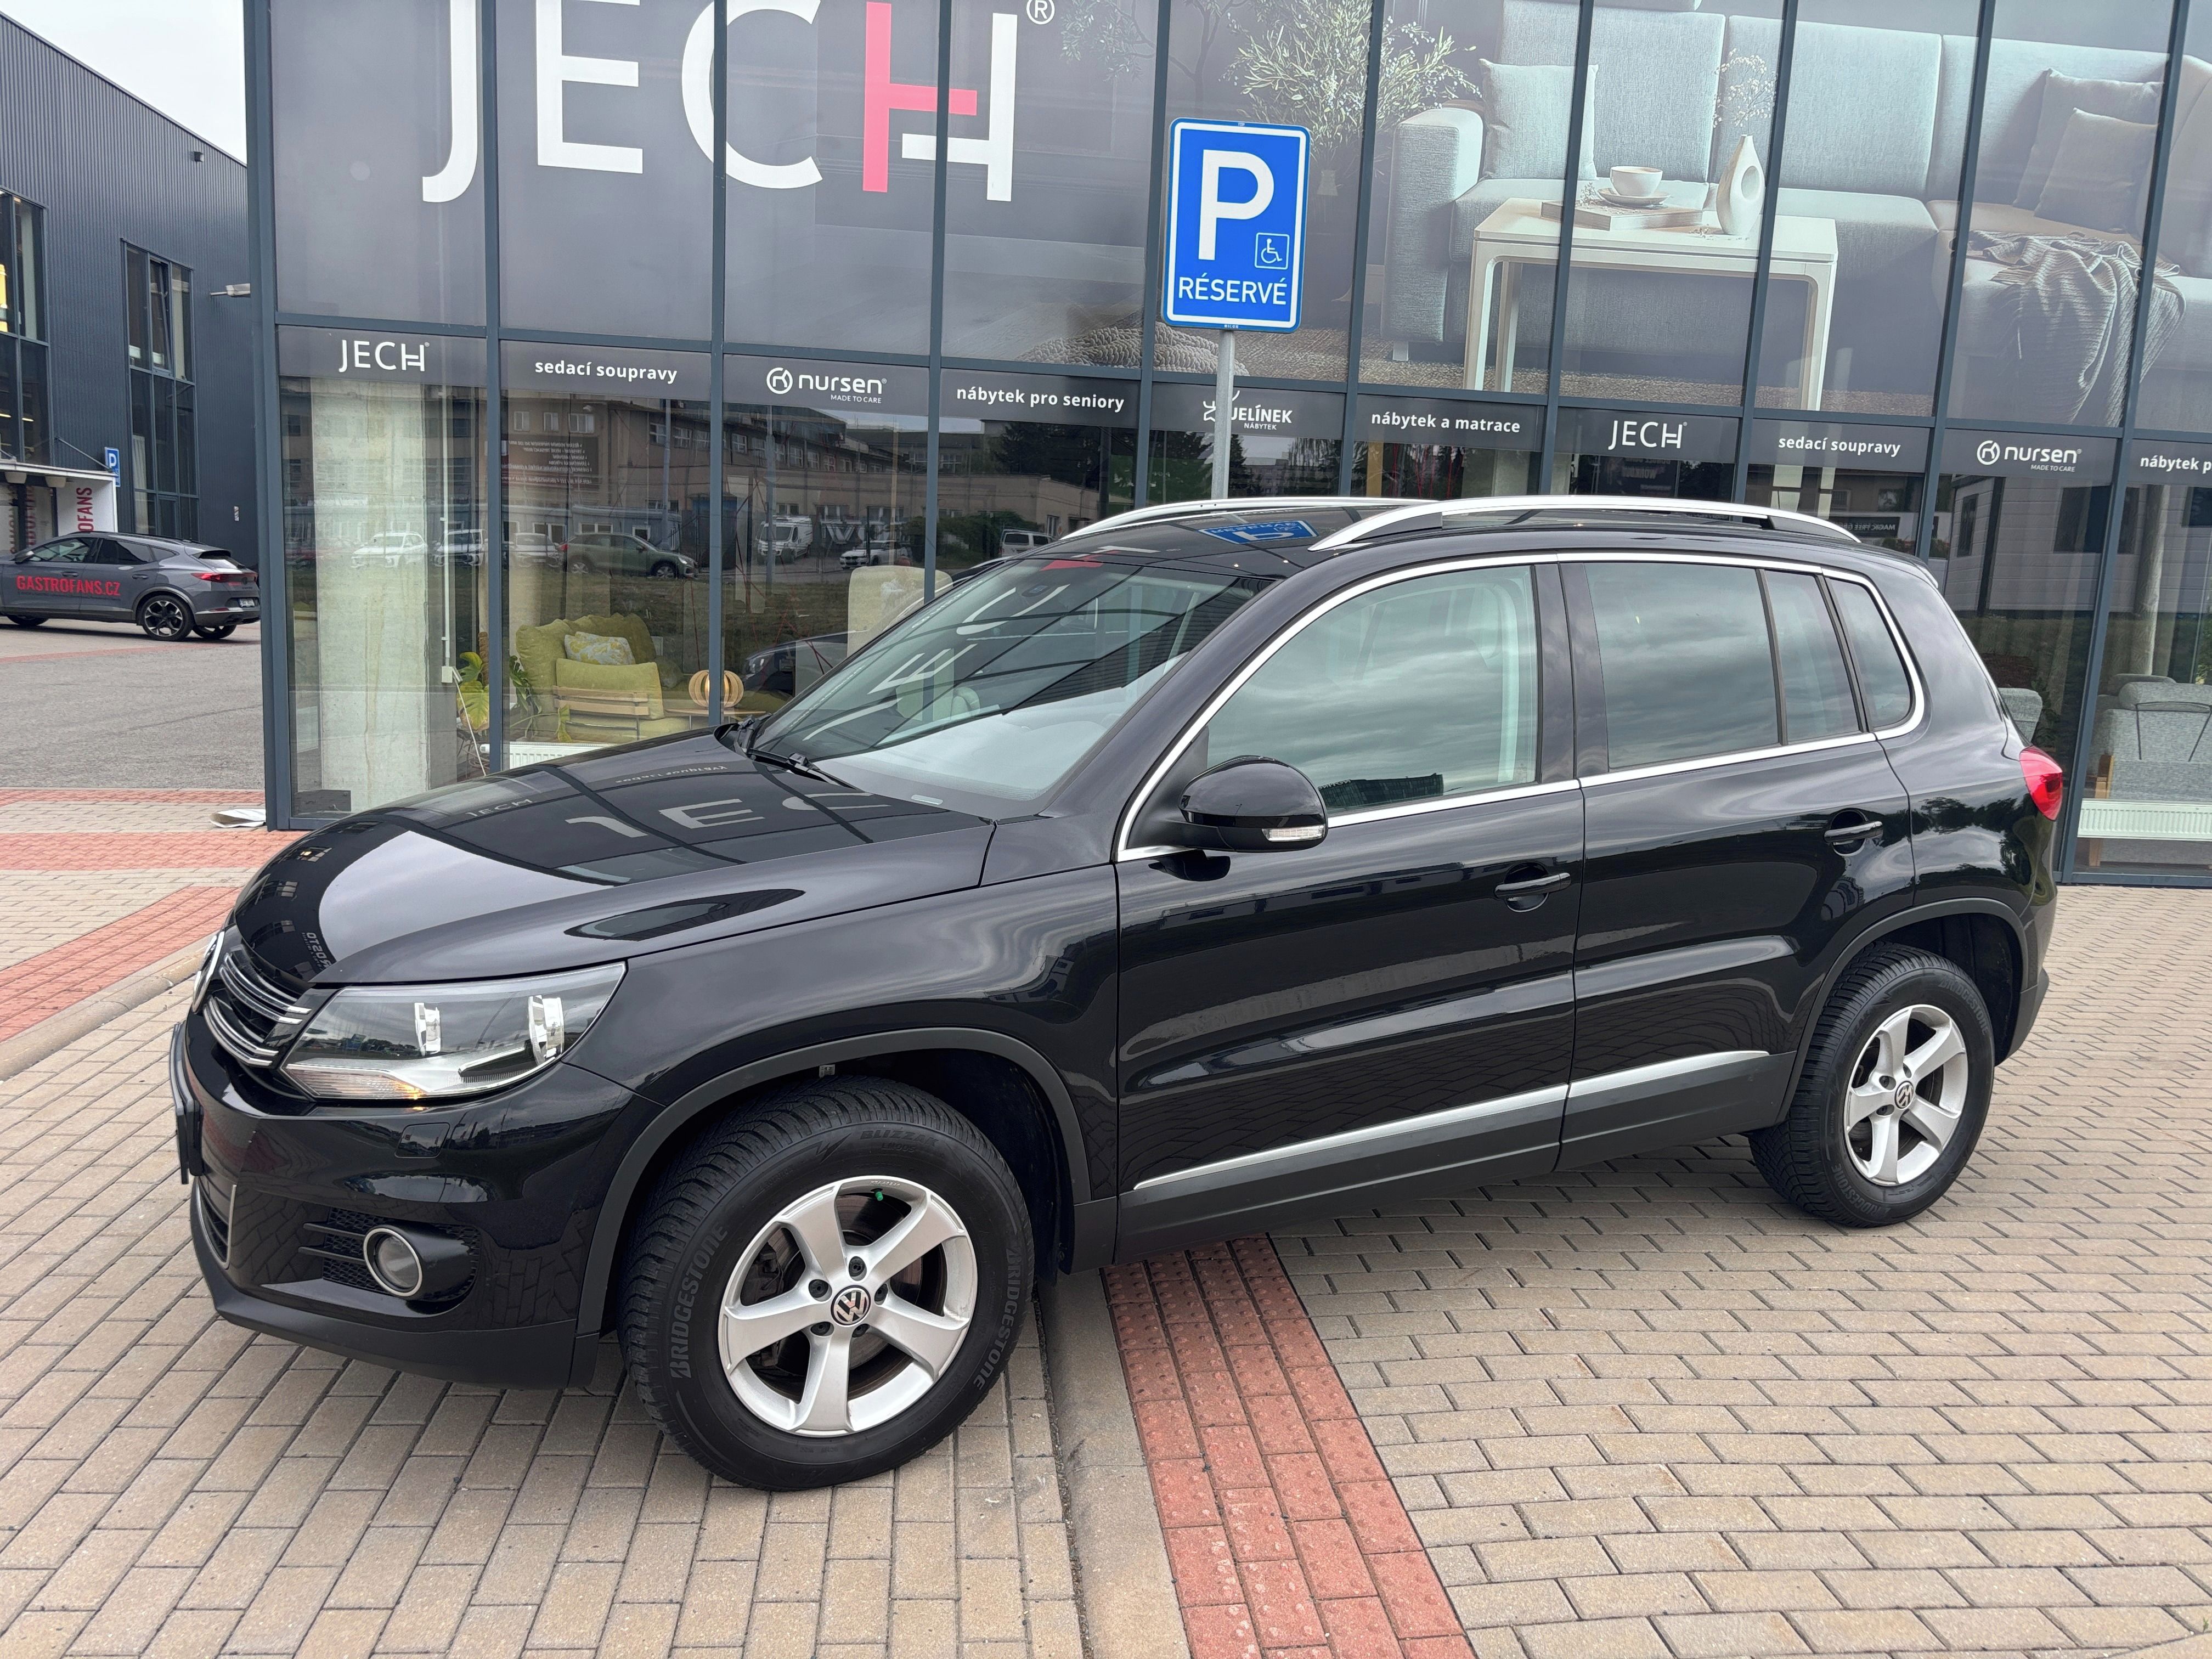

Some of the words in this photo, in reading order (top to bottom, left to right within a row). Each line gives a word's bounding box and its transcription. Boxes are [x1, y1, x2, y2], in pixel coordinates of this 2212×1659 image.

[1198, 149, 1274, 261] P
[1178, 272, 1287, 305] RÉSERVÉ
[338, 340, 426, 373] JECH
[535, 360, 592, 376] sedací
[596, 366, 678, 385] soupravy
[798, 374, 883, 394] nursen
[957, 386, 1025, 405] nábytek
[1030, 393, 1058, 408] pro
[1063, 394, 1124, 413] seniory
[1231, 404, 1293, 424] JELÍNEK
[1244, 422, 1277, 431] NÁBYTEK
[1372, 411, 1436, 430] nábytek
[1441, 418, 1449, 428] a
[1455, 419, 1520, 433] matrace
[1608, 420, 1683, 450] JECH
[1778, 436, 1828, 450] sedací
[1830, 441, 1901, 458] soupravy
[2004, 446, 2078, 464] nursen
[2140, 455, 2199, 472] nábytek
[76, 487, 94, 533] OFANS
[16, 575, 121, 596] GASTROFANS.CZ
[669, 1221, 728, 1379] BRIDGESTONE
[973, 1247, 1023, 1391] BRIDGESTONE
